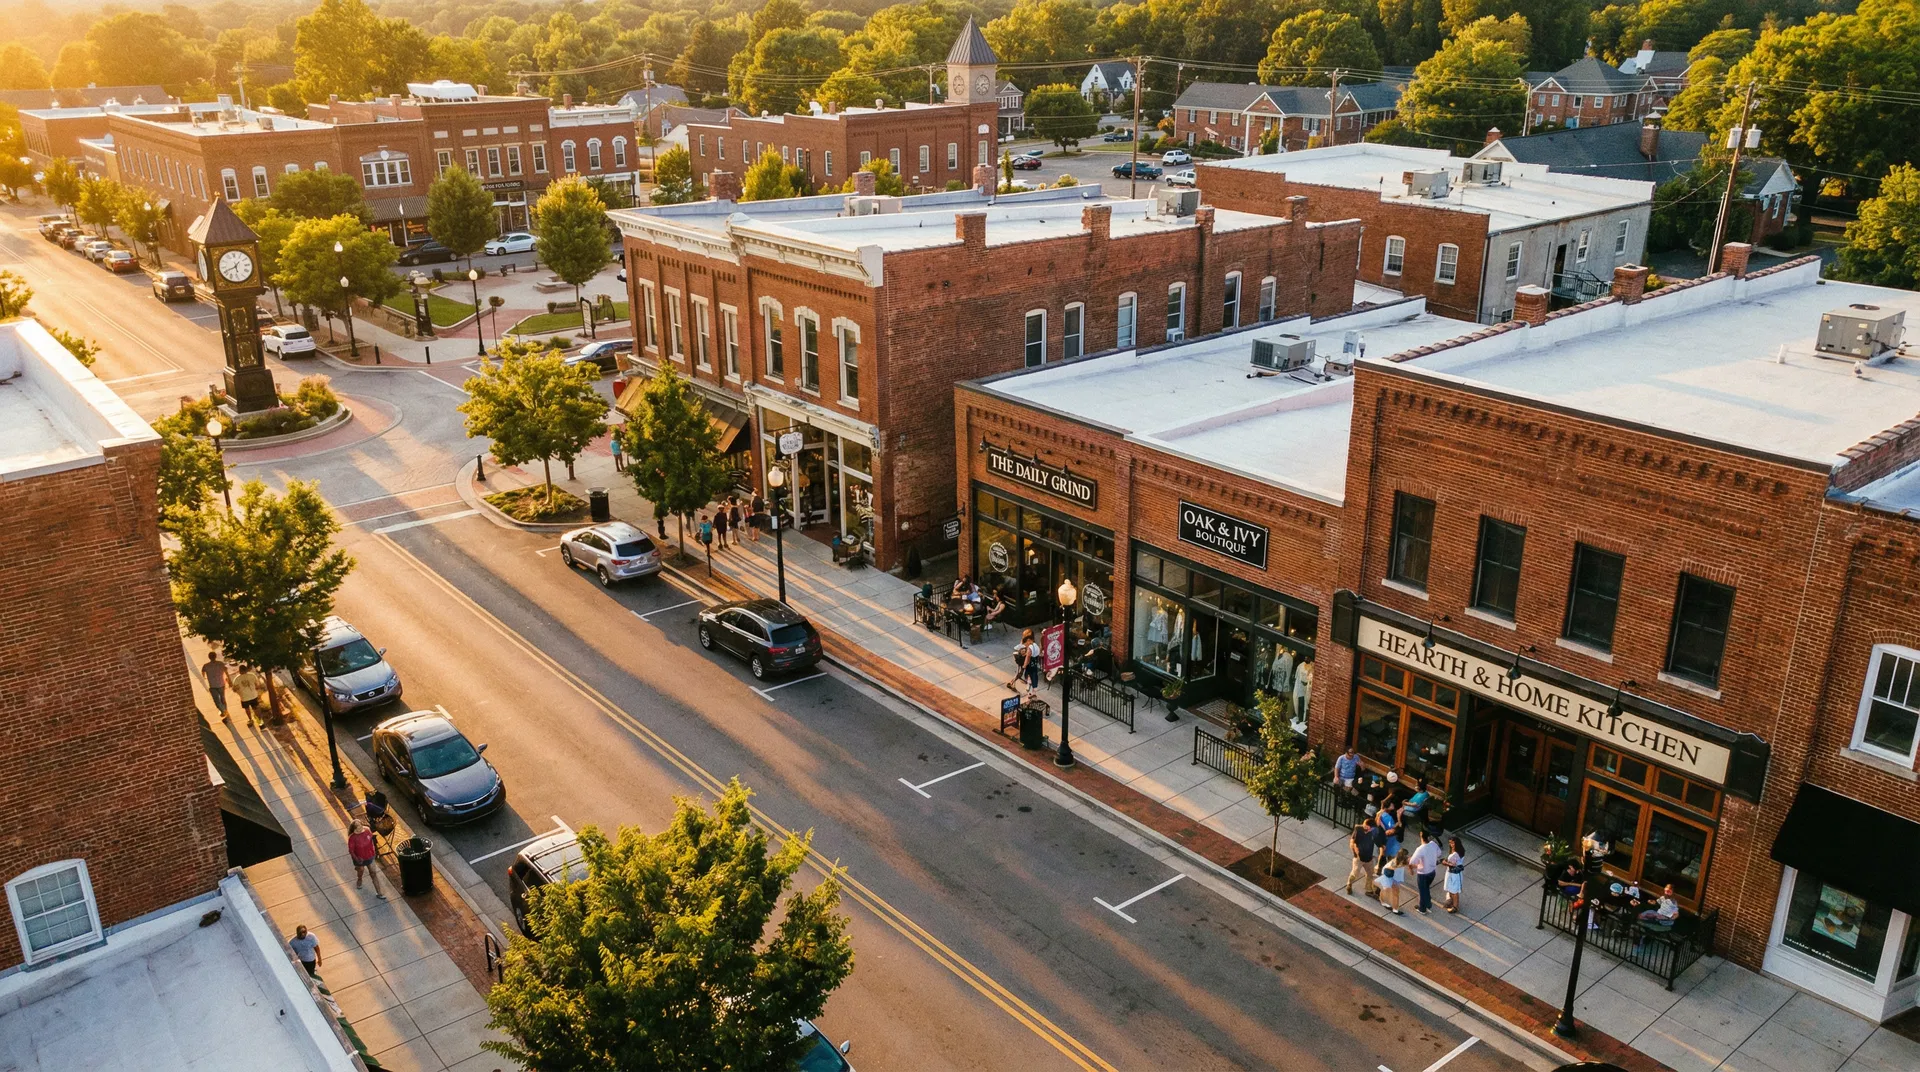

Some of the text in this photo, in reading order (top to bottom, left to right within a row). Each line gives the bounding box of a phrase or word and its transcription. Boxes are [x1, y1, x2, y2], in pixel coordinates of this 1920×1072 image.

[991, 453, 1091, 500] THE DAILY GRIND
[1184, 510, 1261, 548] OAK & IVY
[1196, 529, 1246, 555] BOUTIQUE
[1377, 630, 1702, 766] HEARTH & HOME KITCHEN
